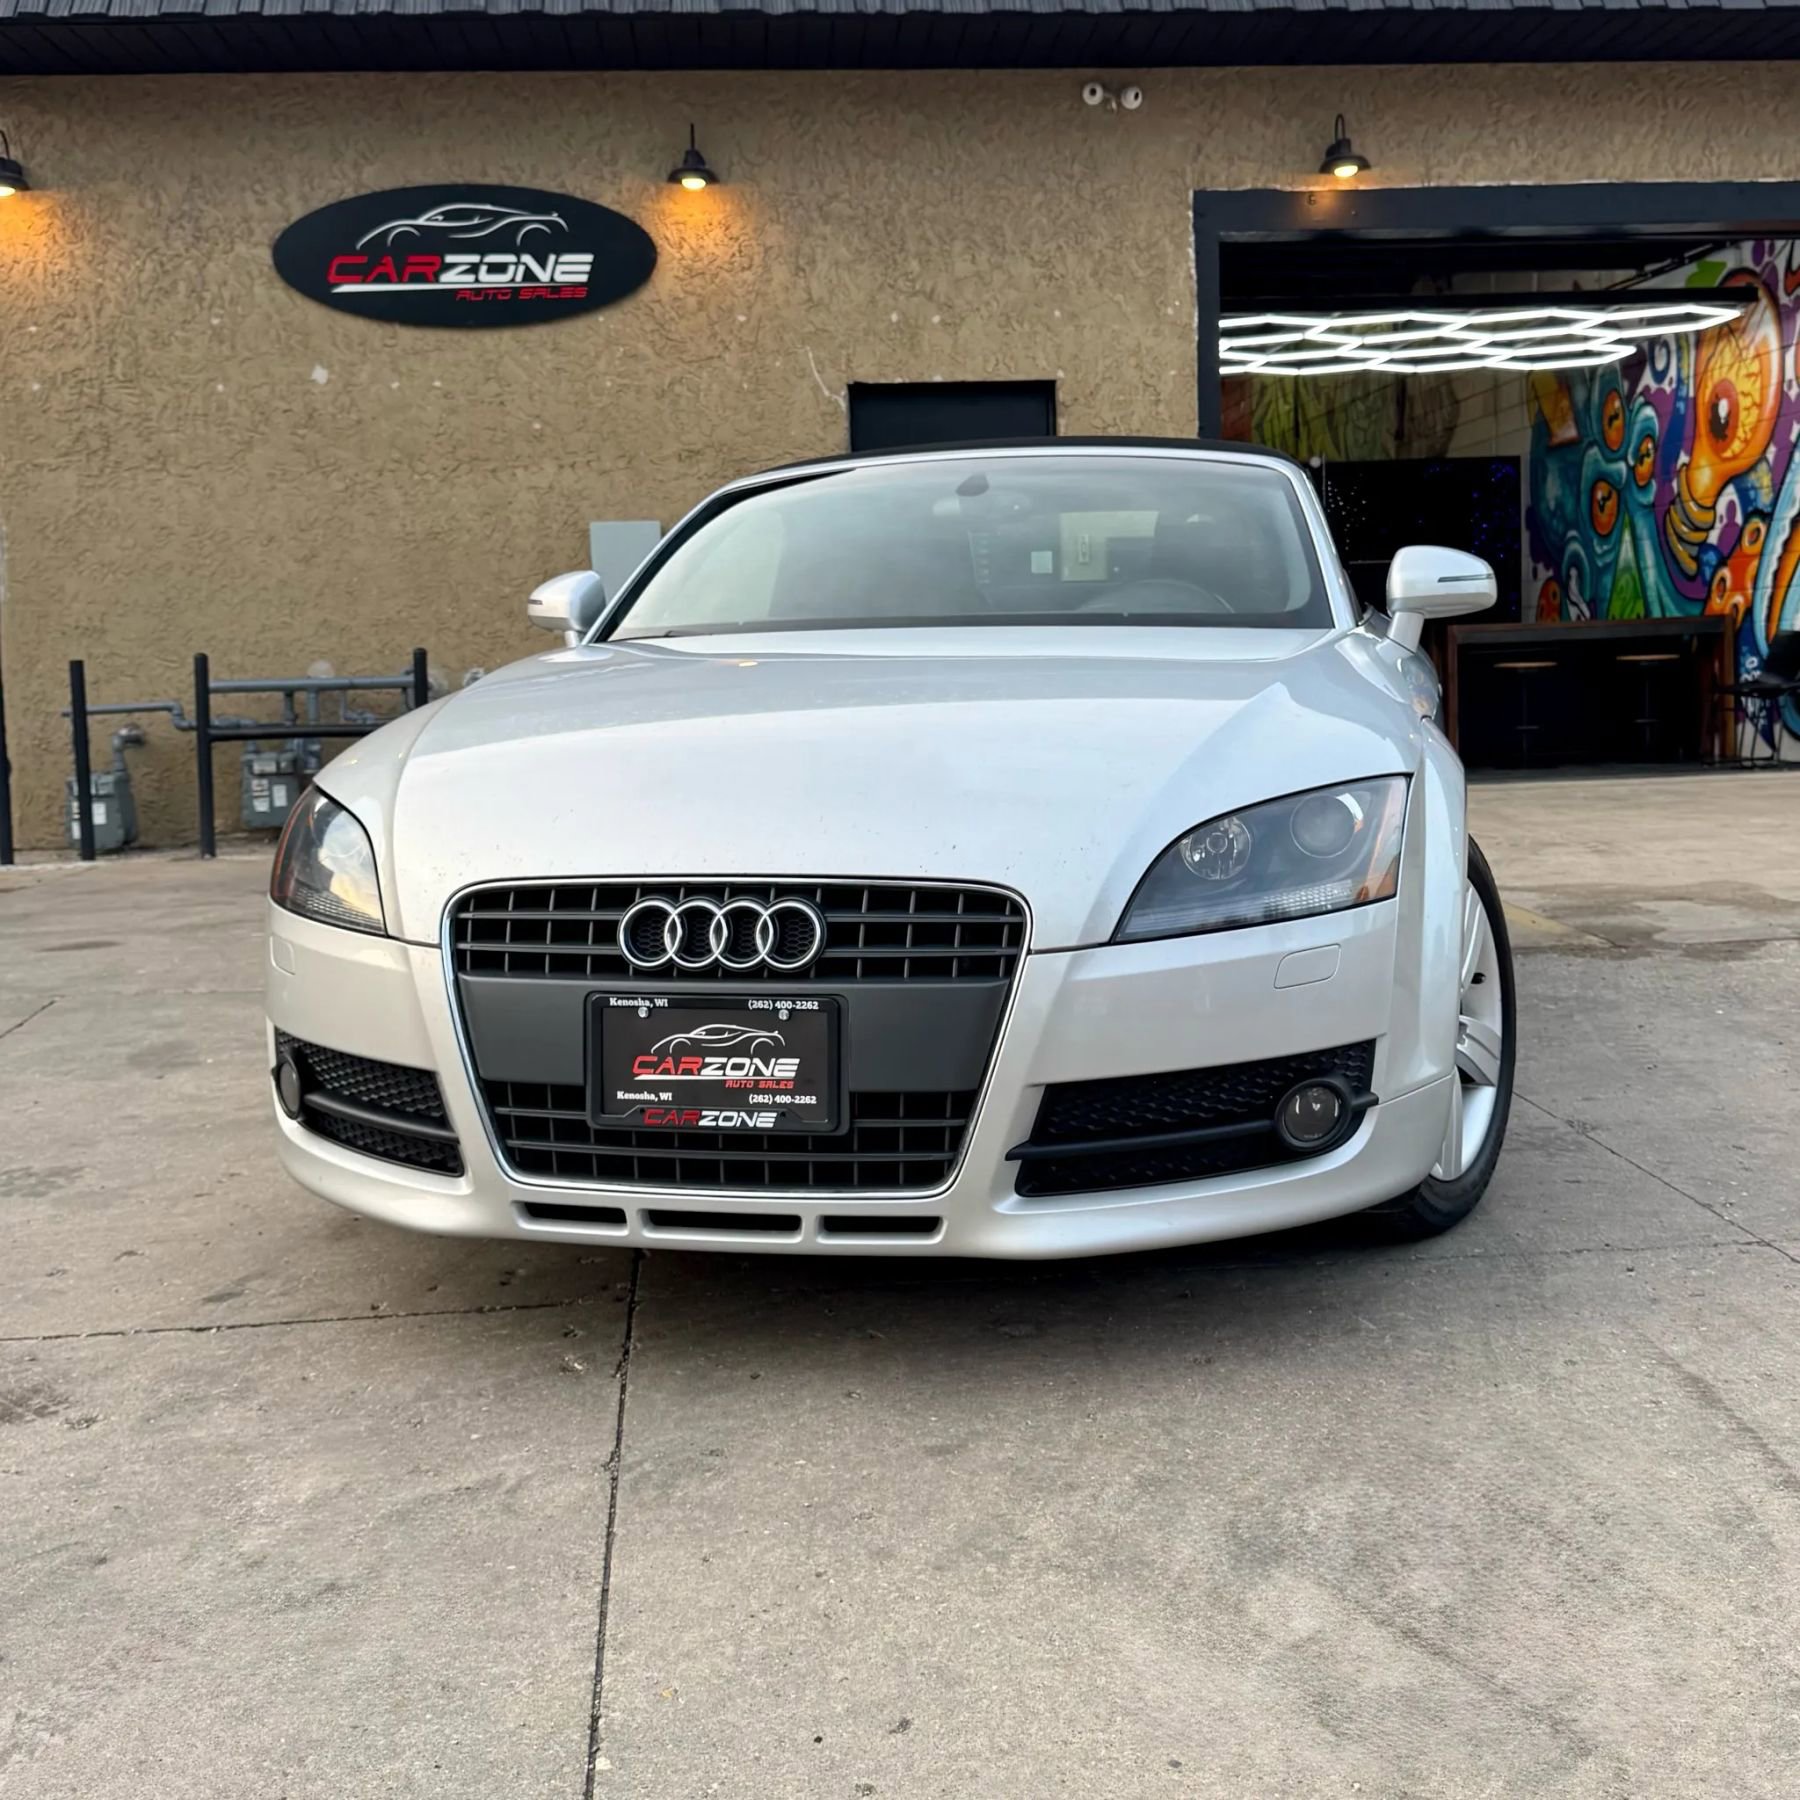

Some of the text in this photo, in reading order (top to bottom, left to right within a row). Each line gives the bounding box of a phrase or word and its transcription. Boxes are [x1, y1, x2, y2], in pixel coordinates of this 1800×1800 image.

[327, 253, 594, 284] CARZONE
[456, 286, 588, 302] AUTO SALES
[609, 997, 669, 1009] Kenosha, WI
[748, 999, 819, 1010] (262) 400-2262
[632, 1055, 800, 1077] CARZONE
[725, 1079, 794, 1089] AUTO SALES
[616, 1091, 673, 1102] Kenosha, WI
[748, 1094, 817, 1105] (262) 400-2262
[643, 1108, 778, 1128] CARZONE
